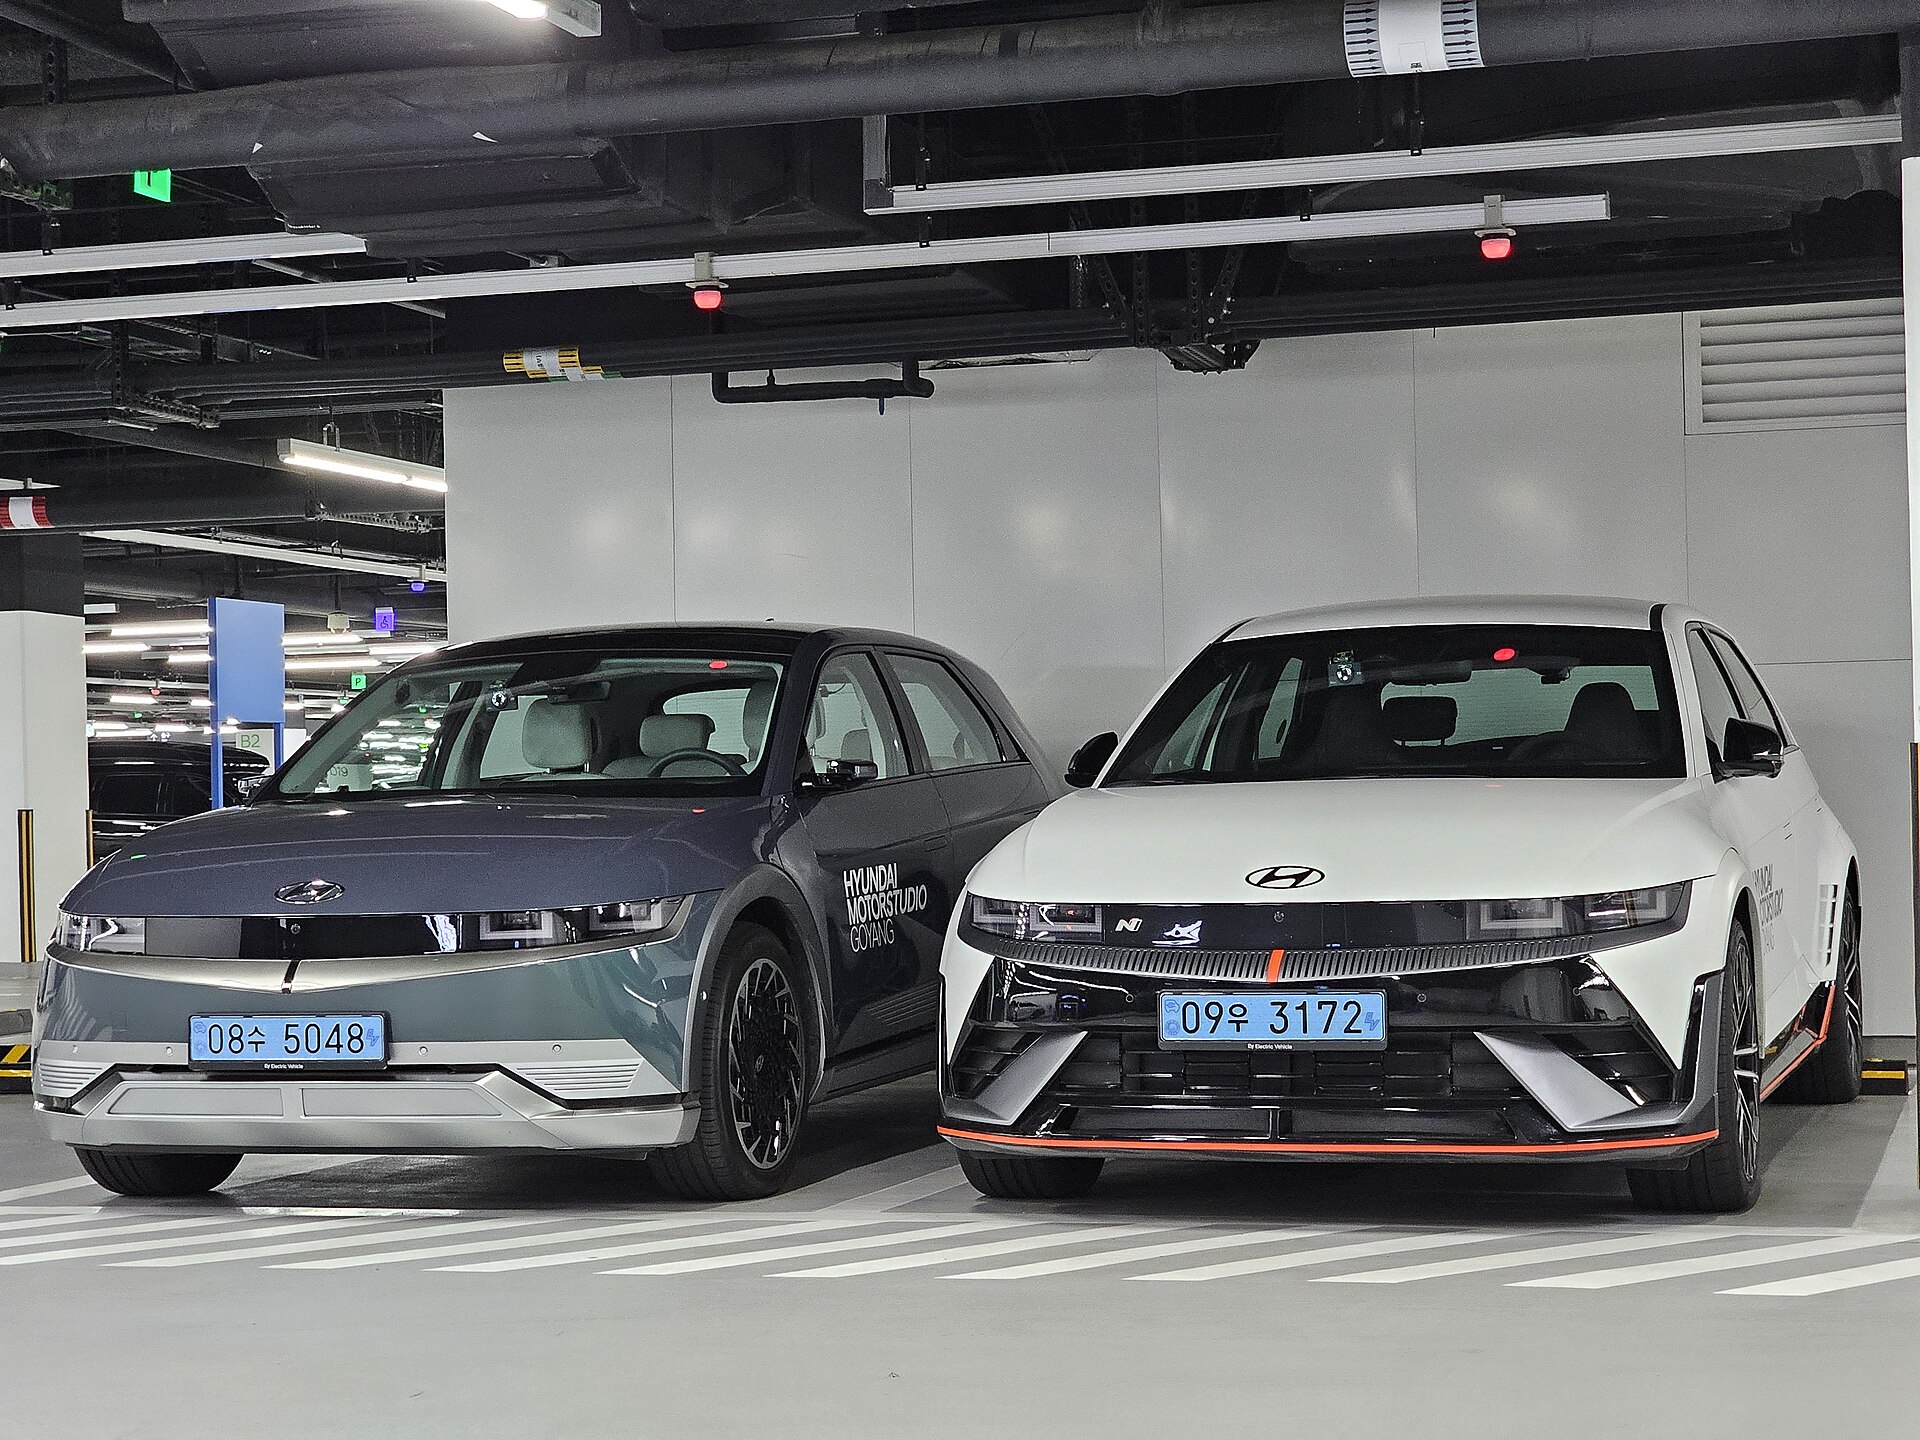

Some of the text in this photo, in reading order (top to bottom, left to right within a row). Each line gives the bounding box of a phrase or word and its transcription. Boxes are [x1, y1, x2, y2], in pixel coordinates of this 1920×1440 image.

[355, 677, 361, 686] P
[240, 734, 260, 748] B2
[843, 862, 898, 898] HYUNDAI
[846, 884, 928, 926] MOTORSTUDIO
[850, 918, 895, 953] GOYANG
[1181, 1000, 1363, 1034] 09우 3172
[208, 1022, 364, 1054] 08수 5048
